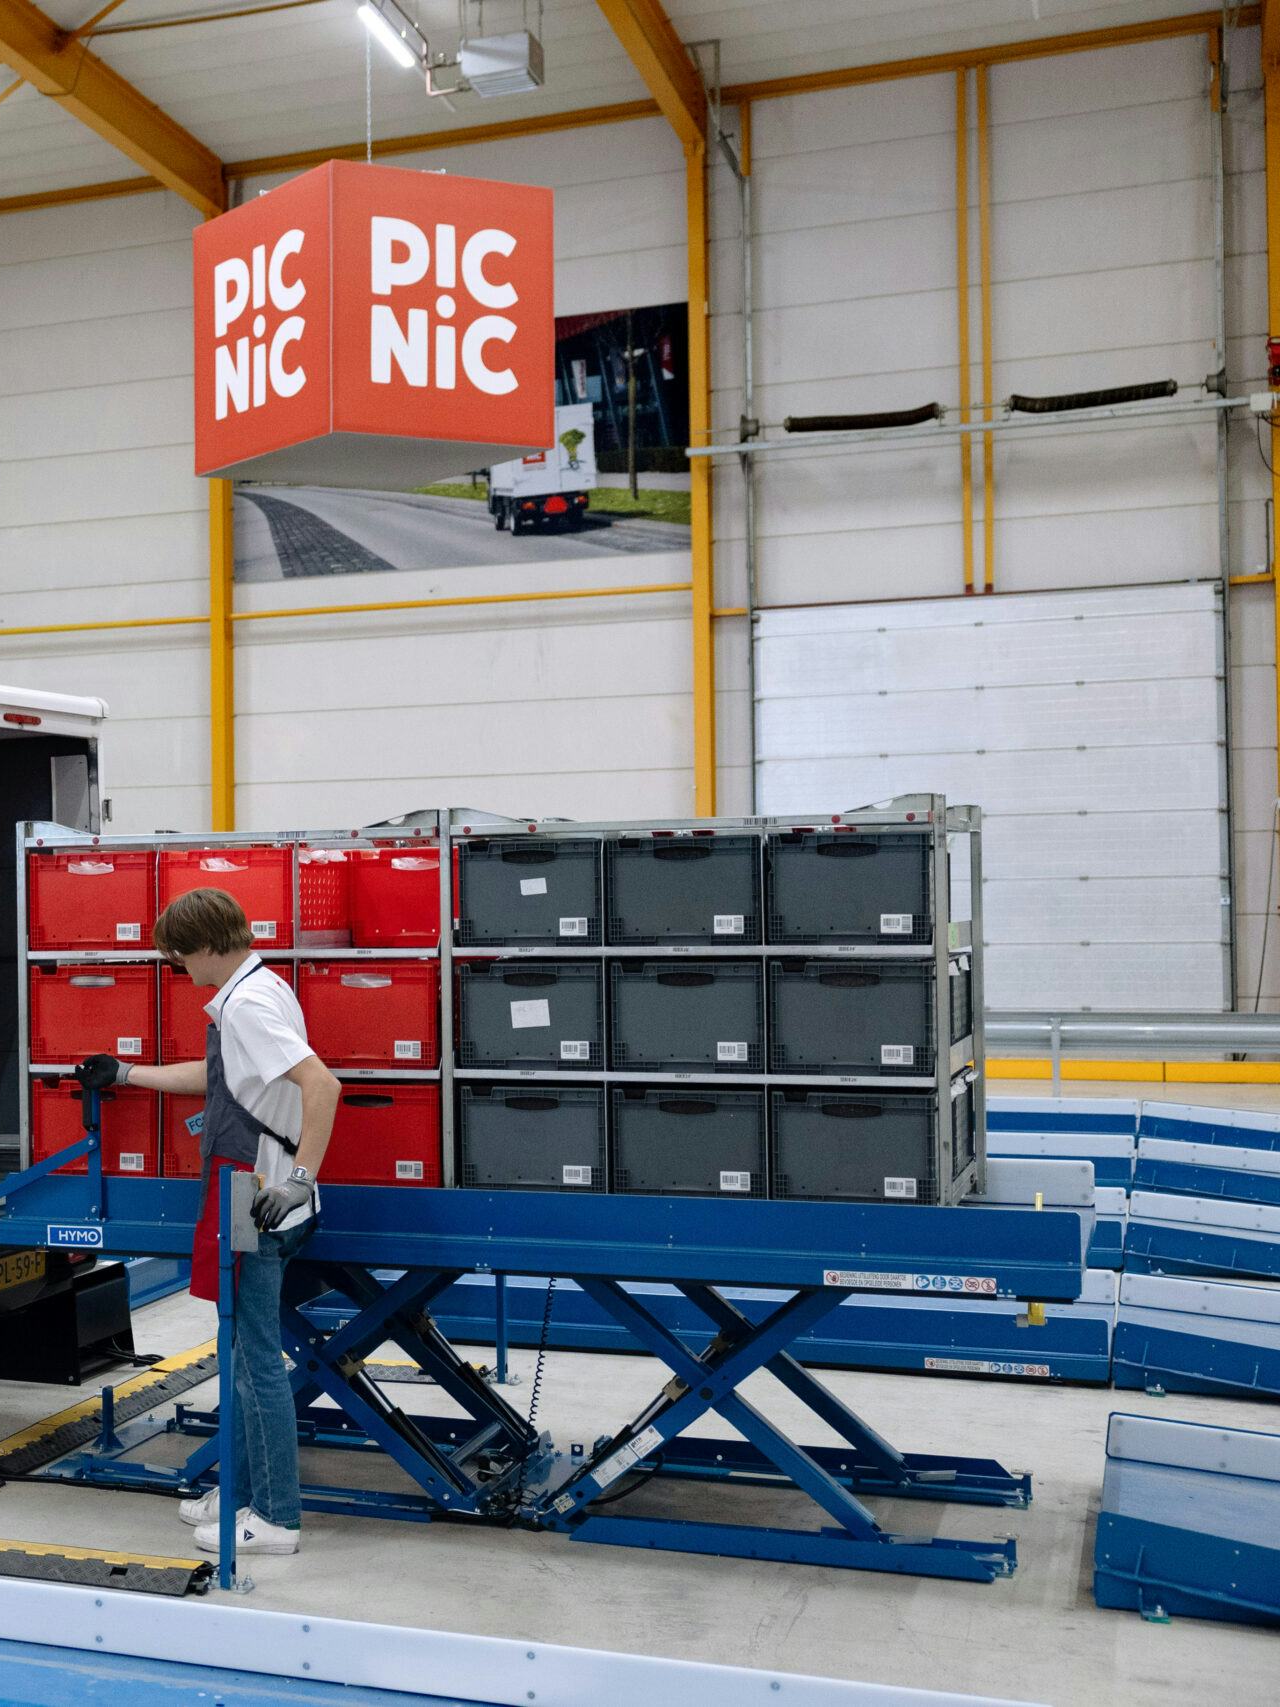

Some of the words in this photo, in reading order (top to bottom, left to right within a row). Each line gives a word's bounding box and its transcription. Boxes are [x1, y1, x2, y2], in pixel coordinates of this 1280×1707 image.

[213, 228, 307, 338] PIC
[370, 215, 519, 310] PIC
[188, 1116, 206, 1131] FC
[58, 1230, 99, 1242] HYMO
